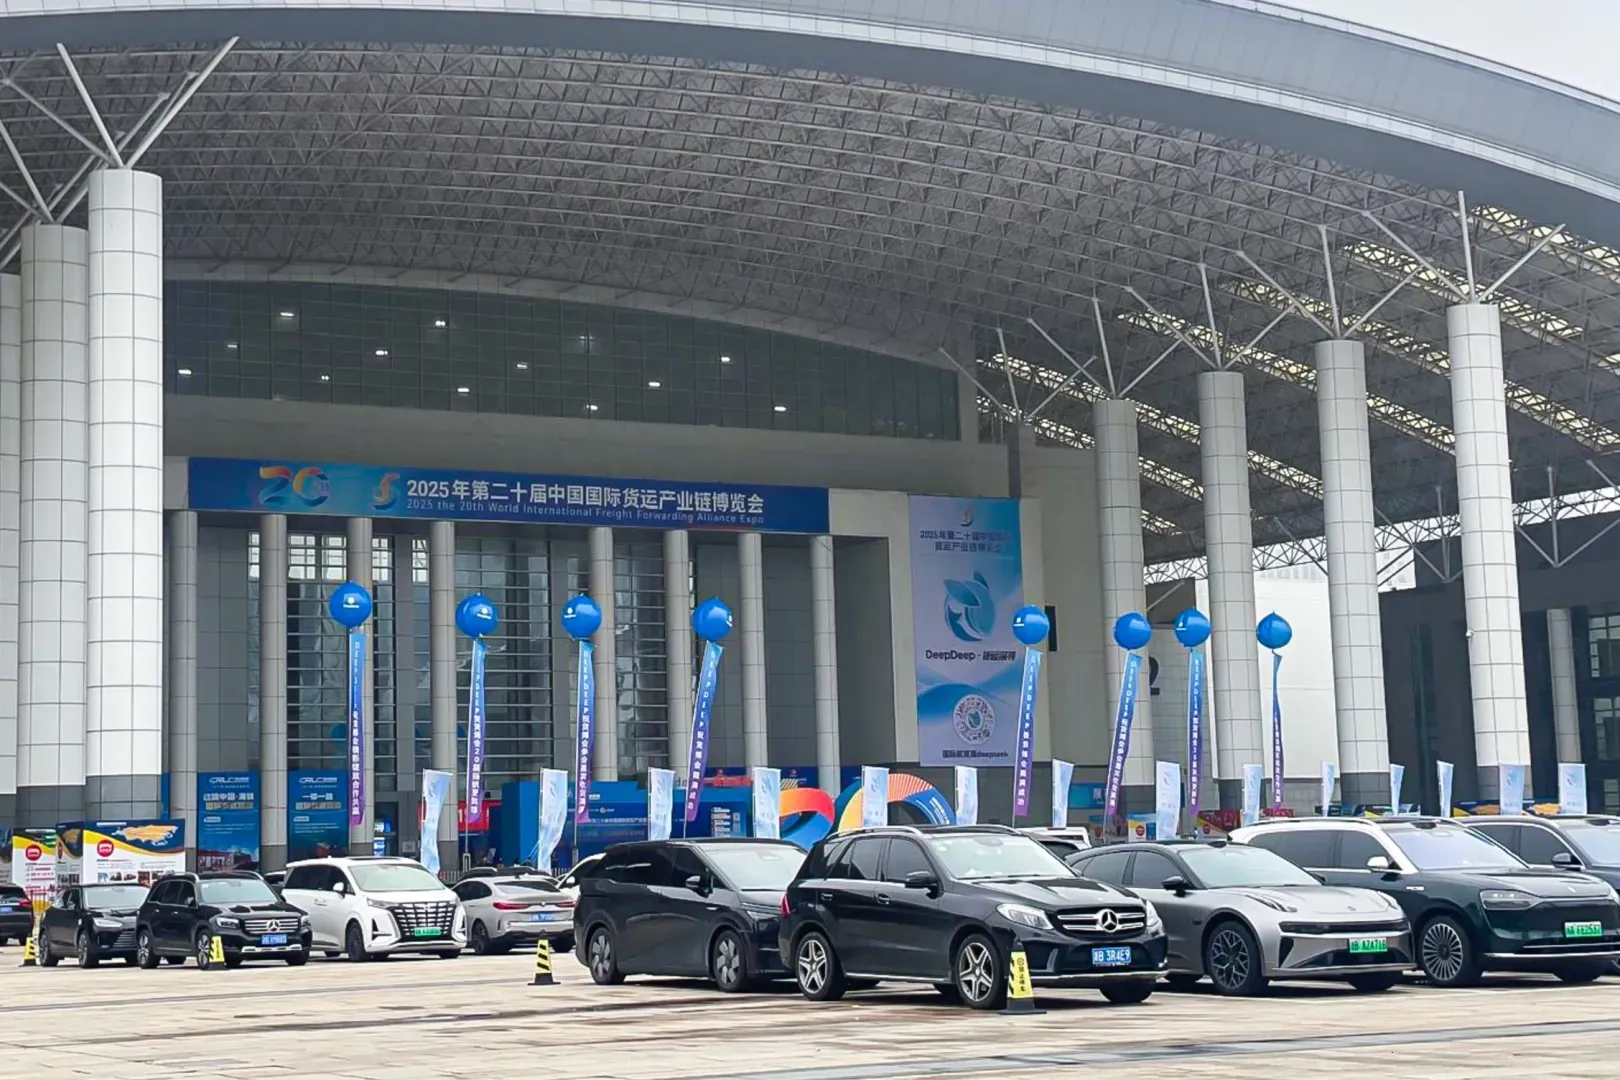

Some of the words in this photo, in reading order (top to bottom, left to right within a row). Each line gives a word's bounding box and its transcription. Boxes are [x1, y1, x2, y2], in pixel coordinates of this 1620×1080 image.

[407, 479, 764, 513] 2025年第二十届中国国际货运产业链博览会
[406, 498, 433, 509] 2025
[437, 499, 456, 511] the
[459, 500, 484, 511] 20th
[488, 501, 519, 514] World
[523, 504, 592, 517] International
[596, 507, 632, 520] Freight
[636, 510, 693, 524] Forwarding
[697, 512, 736, 523] Alliance
[740, 514, 764, 525] Expo
[925, 649, 976, 662] DeepDeep
